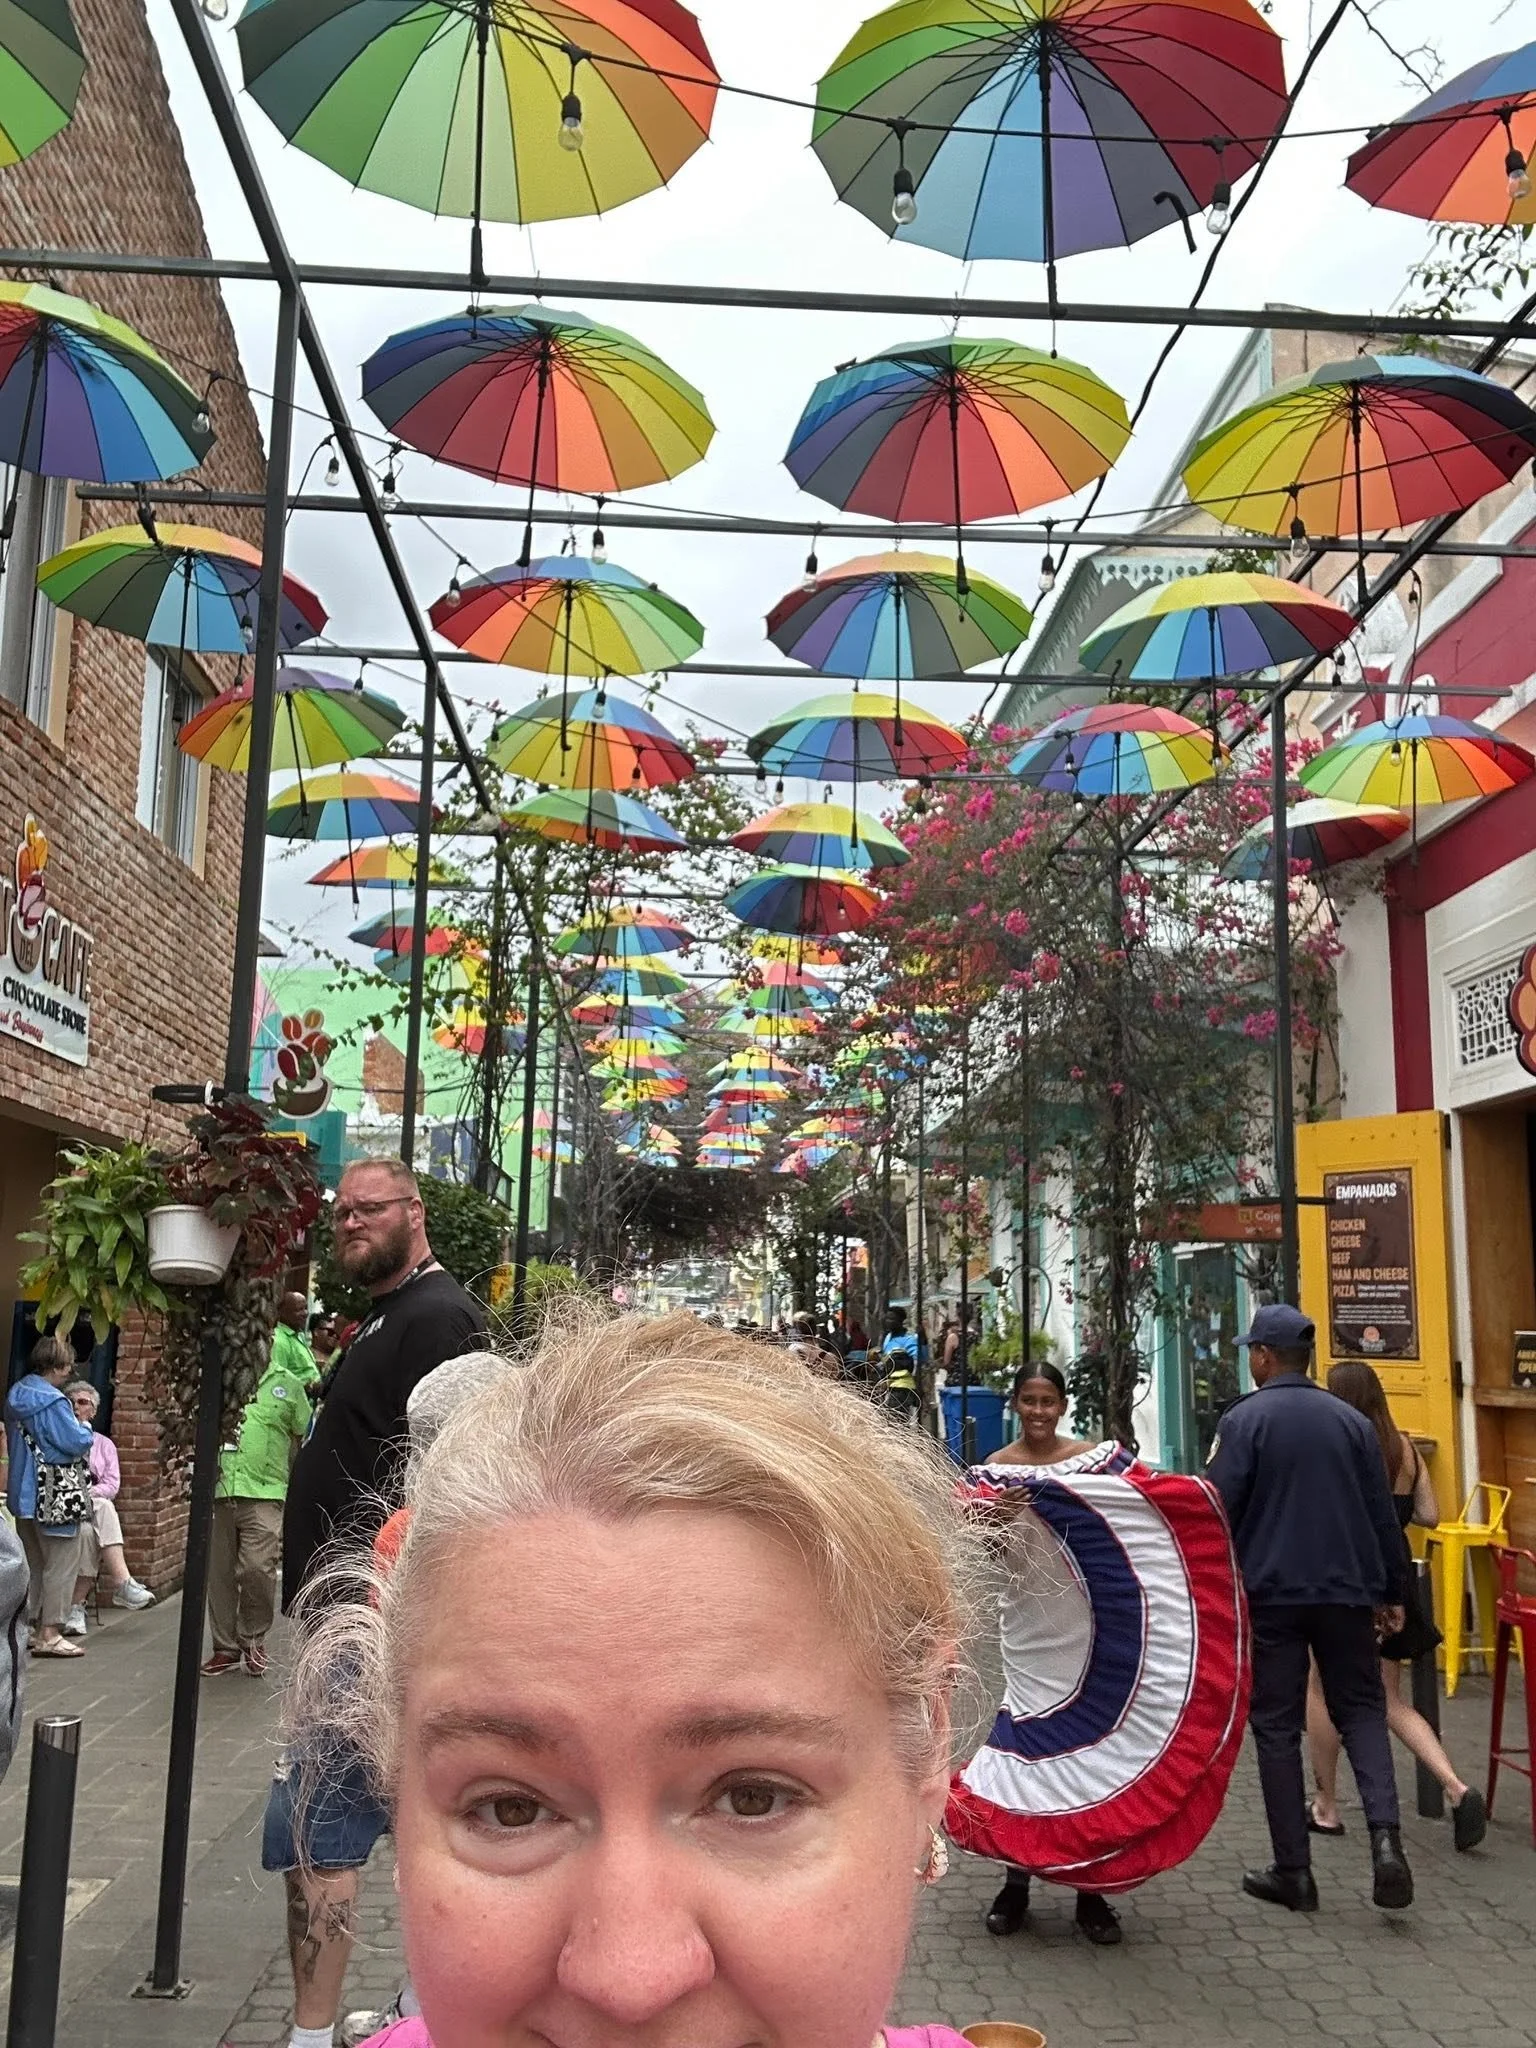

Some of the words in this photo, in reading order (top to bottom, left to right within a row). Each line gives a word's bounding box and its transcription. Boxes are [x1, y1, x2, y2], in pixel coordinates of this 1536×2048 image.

[3, 976, 61, 1022] CHOCOLATE
[61, 1005, 87, 1035] STORE
[1336, 1183, 1397, 1200] EMPANADAS
[1330, 1218, 1366, 1232] CHICKEN
[1331, 1235, 1361, 1249] CHEESE
[1332, 1252, 1351, 1265] BEEF
[1332, 1268, 1352, 1280] HAM
[1353, 1268, 1372, 1280] AND
[1373, 1267, 1409, 1280] CHEESE
[1333, 1284, 1356, 1297] PIZZA
